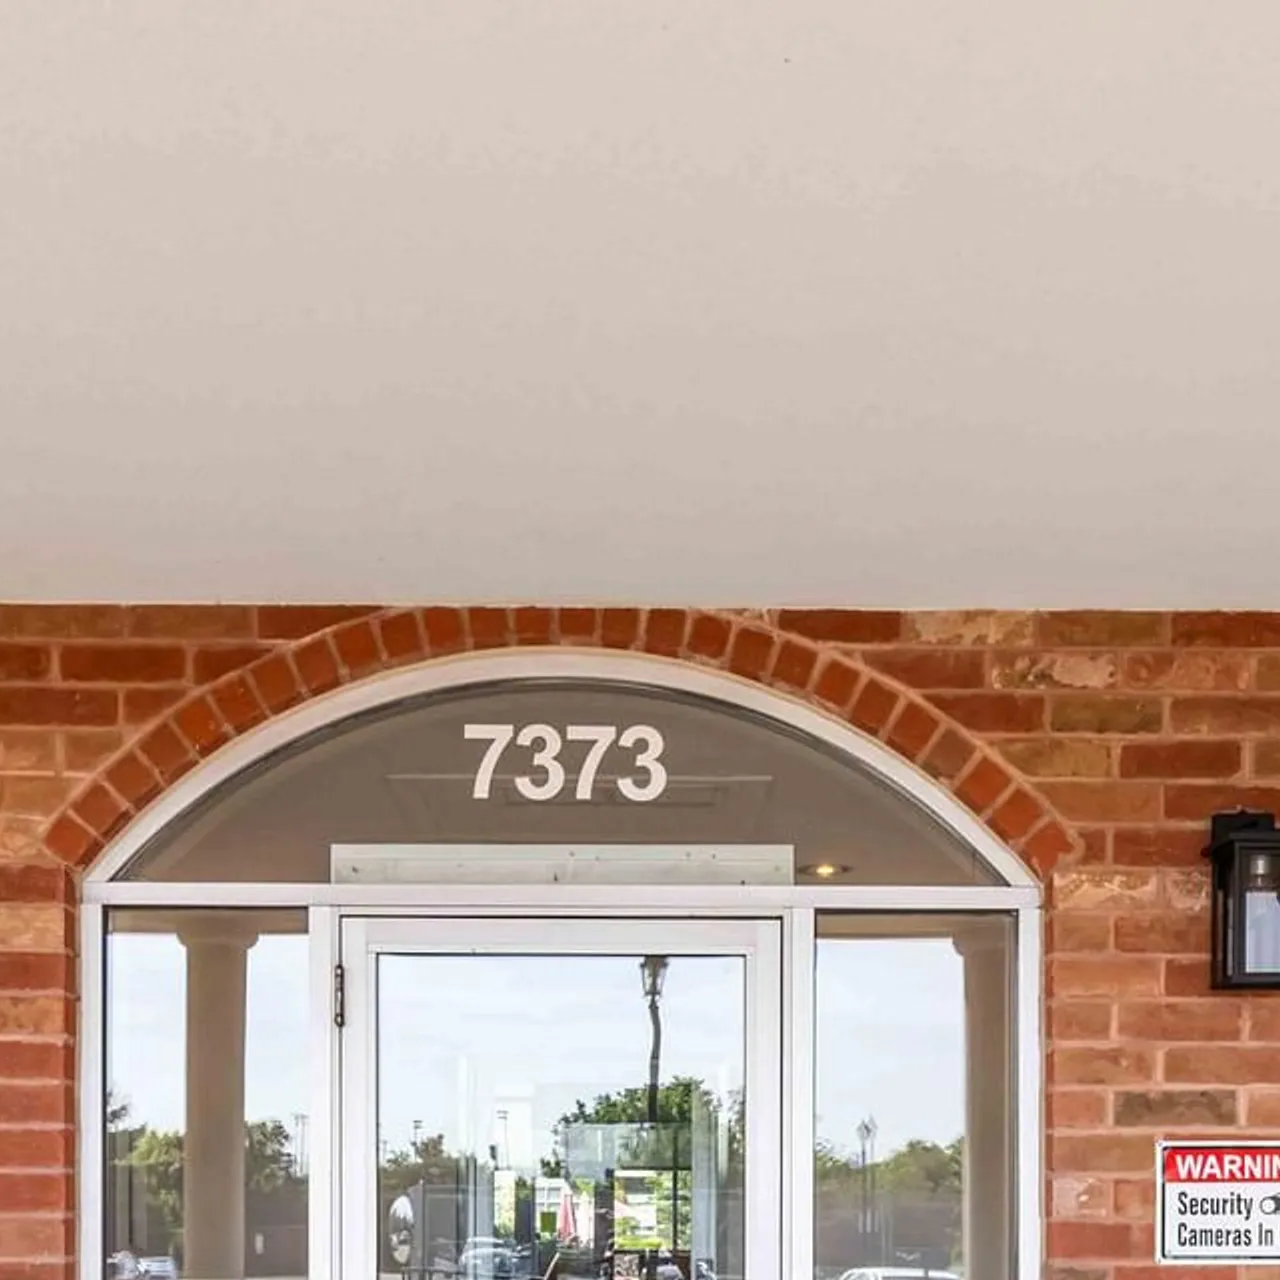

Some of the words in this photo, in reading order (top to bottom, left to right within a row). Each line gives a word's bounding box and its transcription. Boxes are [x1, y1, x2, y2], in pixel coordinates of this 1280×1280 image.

[463, 723, 668, 802] 7373
[1177, 1190, 1254, 1221] Security
[1177, 1221, 1252, 1247] Cameras
[1258, 1222, 1274, 1247] In
